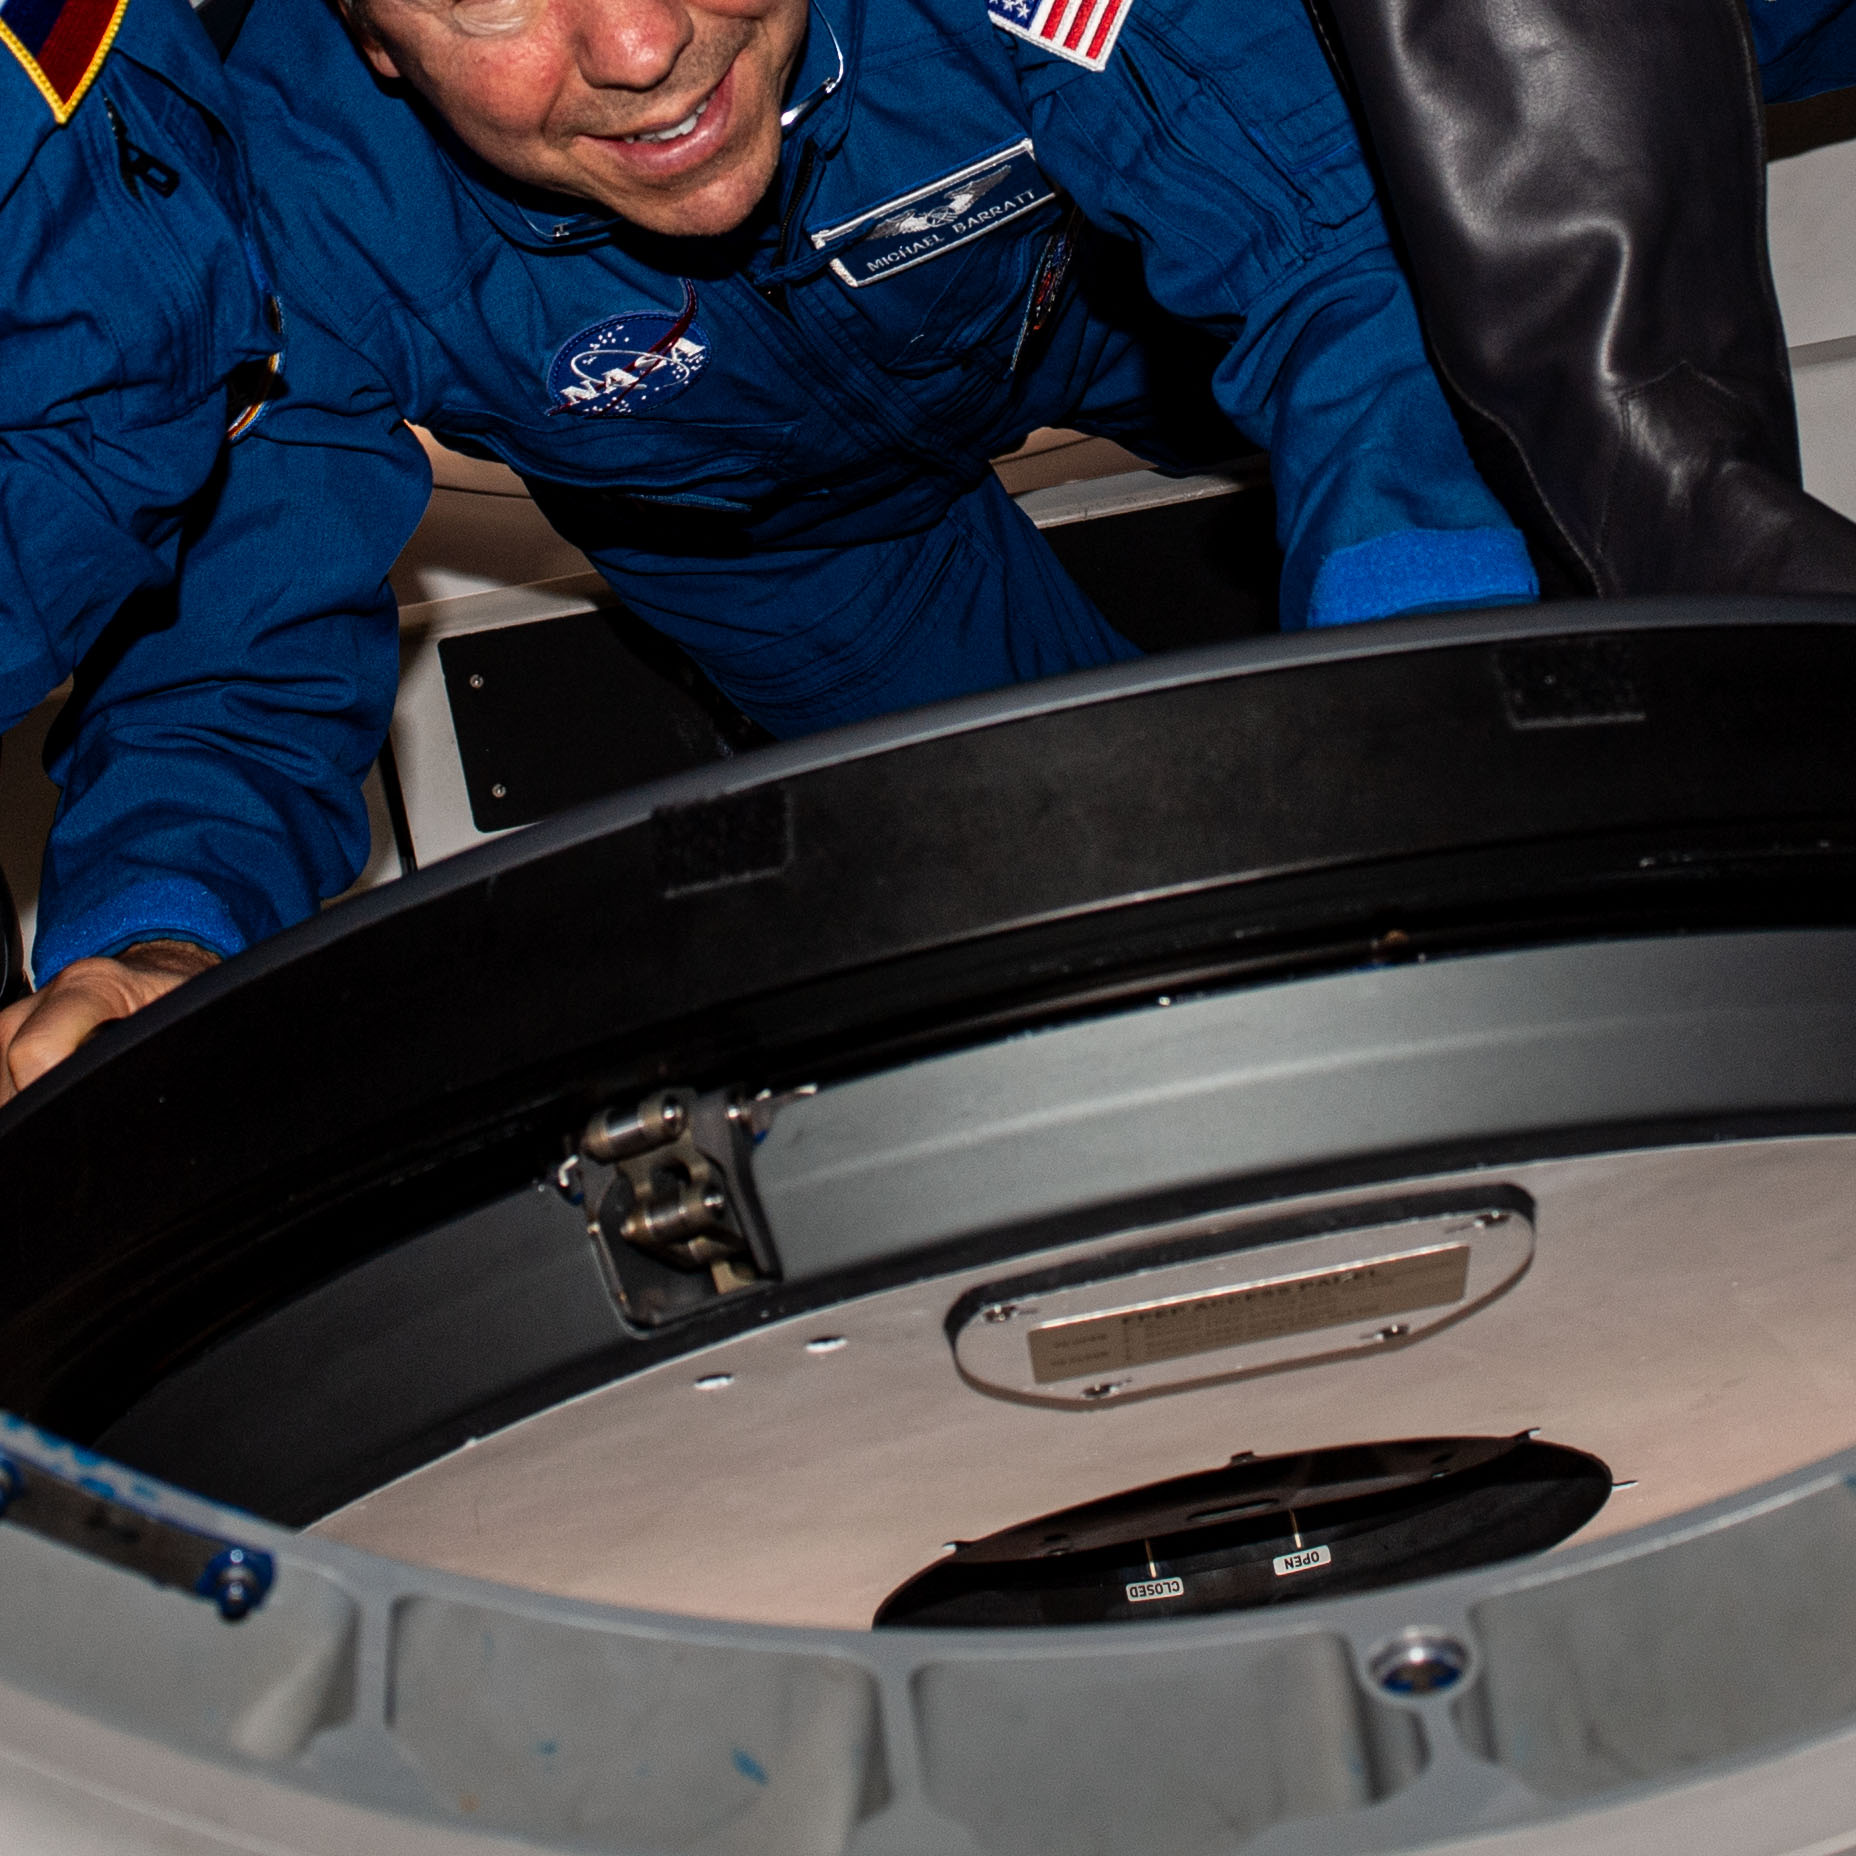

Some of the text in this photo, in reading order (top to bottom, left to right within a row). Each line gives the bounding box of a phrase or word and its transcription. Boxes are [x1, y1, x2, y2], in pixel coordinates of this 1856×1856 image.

[866, 189, 1036, 273] MICHAEL BARRATT
[560, 337, 707, 406] NASA
[1284, 1550, 1320, 1570] OPEN
[1129, 1580, 1181, 1598] CLOSED
